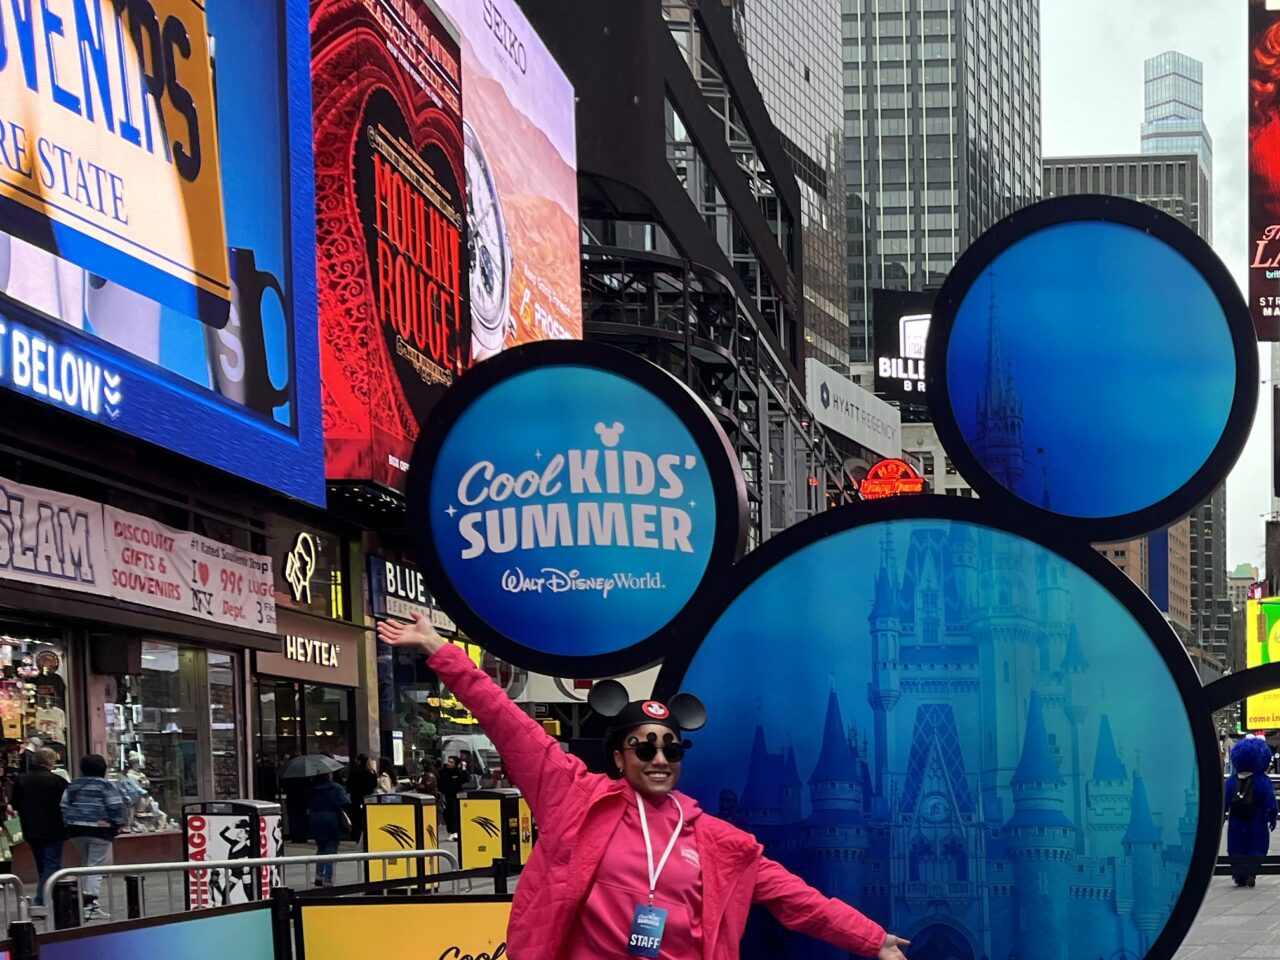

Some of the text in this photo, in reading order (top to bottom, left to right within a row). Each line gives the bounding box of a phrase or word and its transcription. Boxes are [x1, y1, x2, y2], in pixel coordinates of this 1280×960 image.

[483, 0, 528, 75] SEIKO
[0, 0, 201, 183] VENIRS
[38, 137, 129, 226] STATE
[374, 152, 455, 290] MOULIN
[12, 329, 100, 415] BELOW
[833, 394, 897, 441] HYATT REGENCY
[457, 460, 565, 506] Cool
[114, 521, 176, 553] DISCOUNT
[459, 503, 695, 559] SUMMER
[121, 547, 167, 574] GIFTS &
[386, 561, 426, 603] BLUE
[111, 568, 181, 601] SOUVENIRS
[223, 600, 263, 624] Dept. 3
[286, 635, 338, 668] HEYTEA
[188, 816, 208, 909] HICAGO
[630, 934, 660, 949] STAFF
